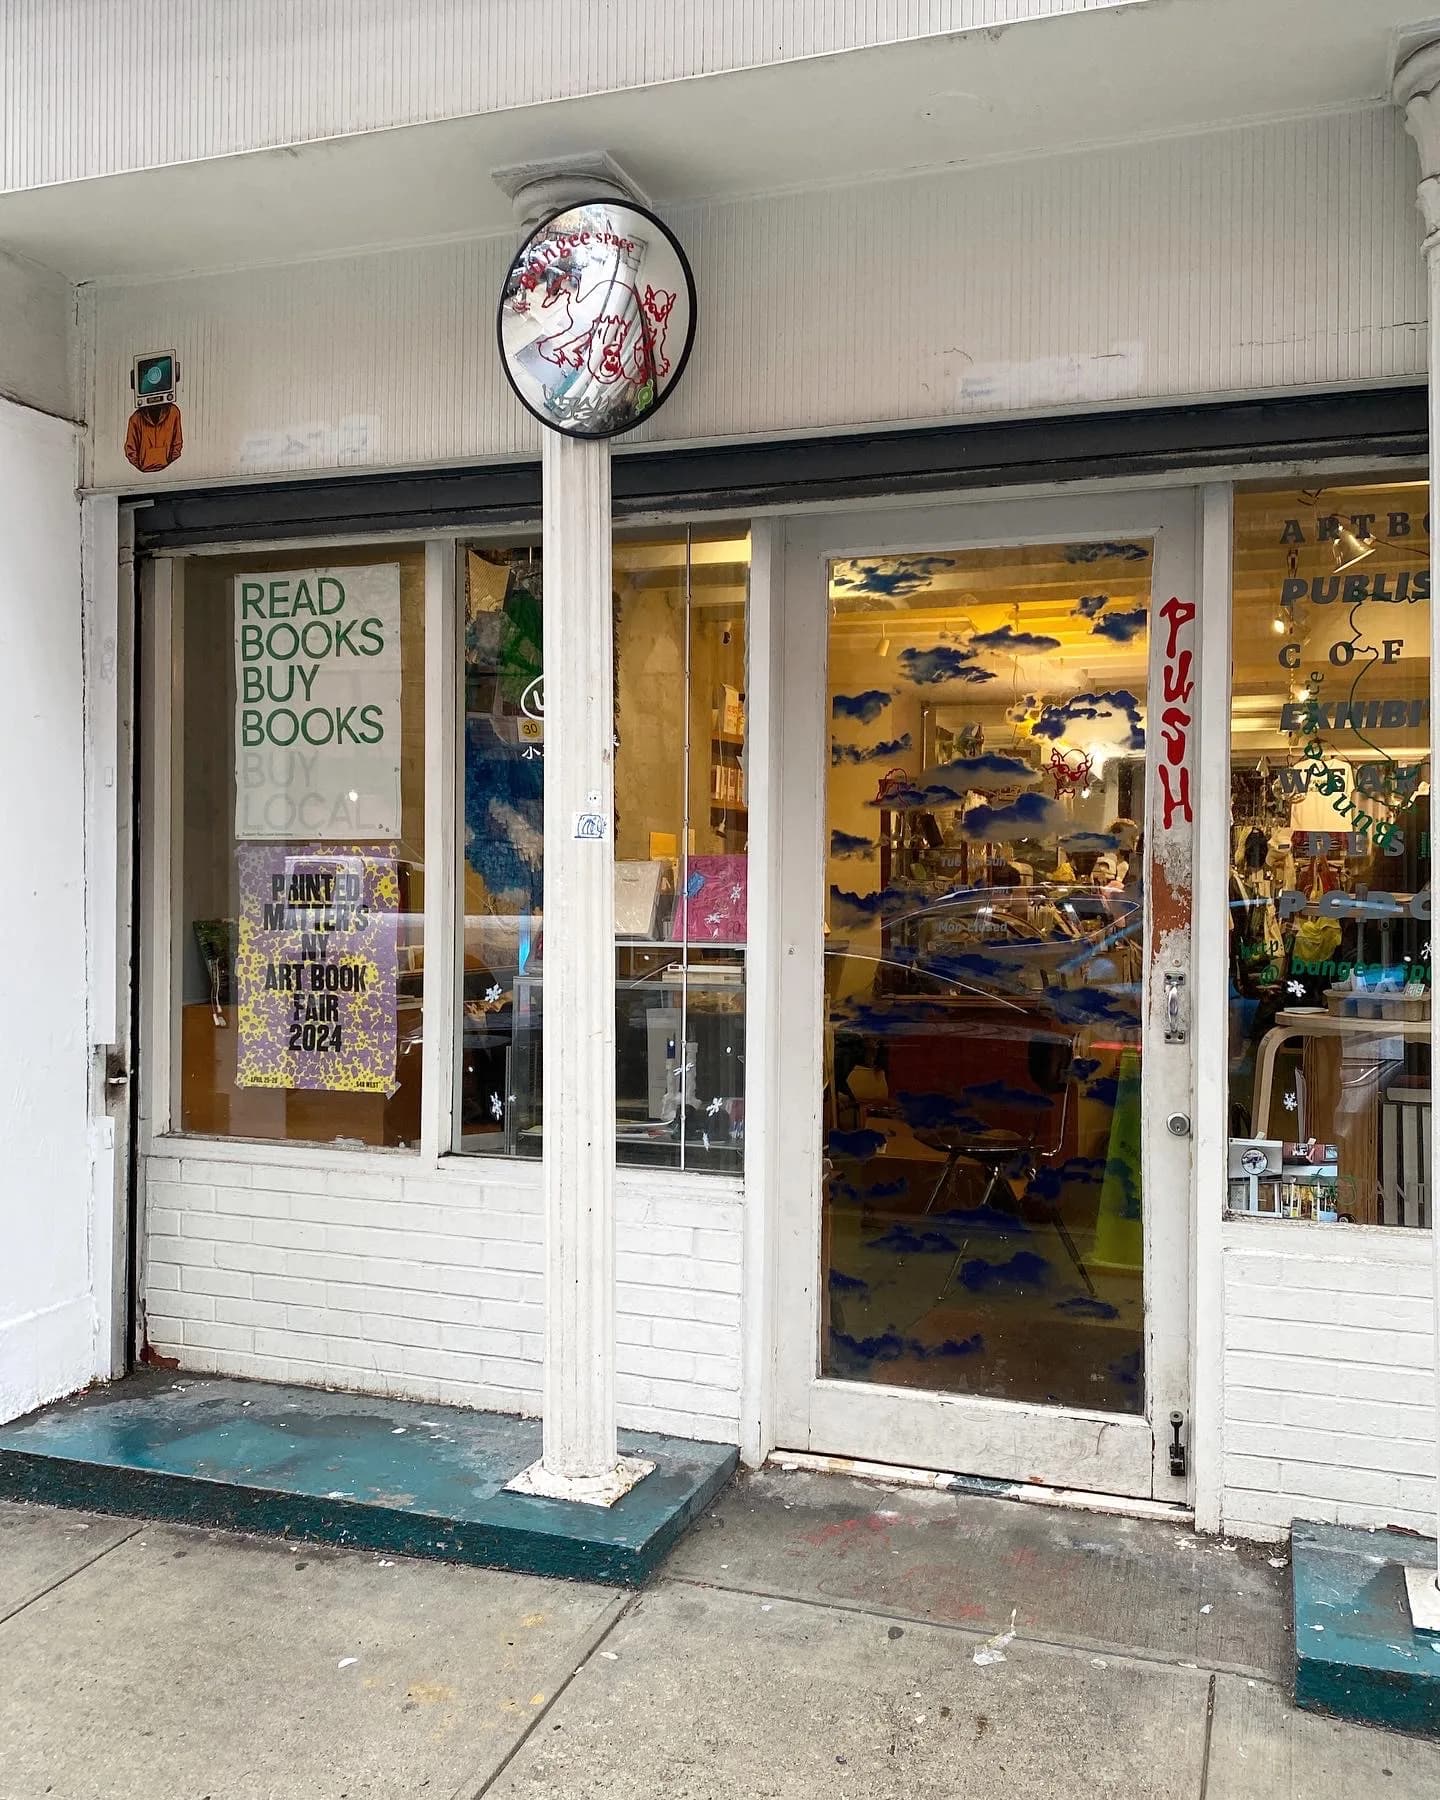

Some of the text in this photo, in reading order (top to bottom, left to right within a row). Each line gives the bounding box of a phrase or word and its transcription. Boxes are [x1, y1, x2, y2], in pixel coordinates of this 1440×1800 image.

[595, 232, 634, 252] space
[242, 577, 345, 619] READ
[242, 618, 384, 661] BOOKS
[243, 664, 320, 703] BUY
[242, 705, 384, 746] BOOKS
[523, 723, 538, 735] 30
[1279, 700, 1430, 730] EXHIBI
[243, 751, 319, 788] BUY
[243, 792, 375, 830] LOCAL
[271, 873, 360, 901] PRINTED
[263, 903, 370, 931] MATTER'S
[301, 934, 330, 961] NY
[265, 964, 366, 992] ART BOOK
[293, 993, 338, 1022] FAIR
[289, 1024, 342, 1052] 2024
